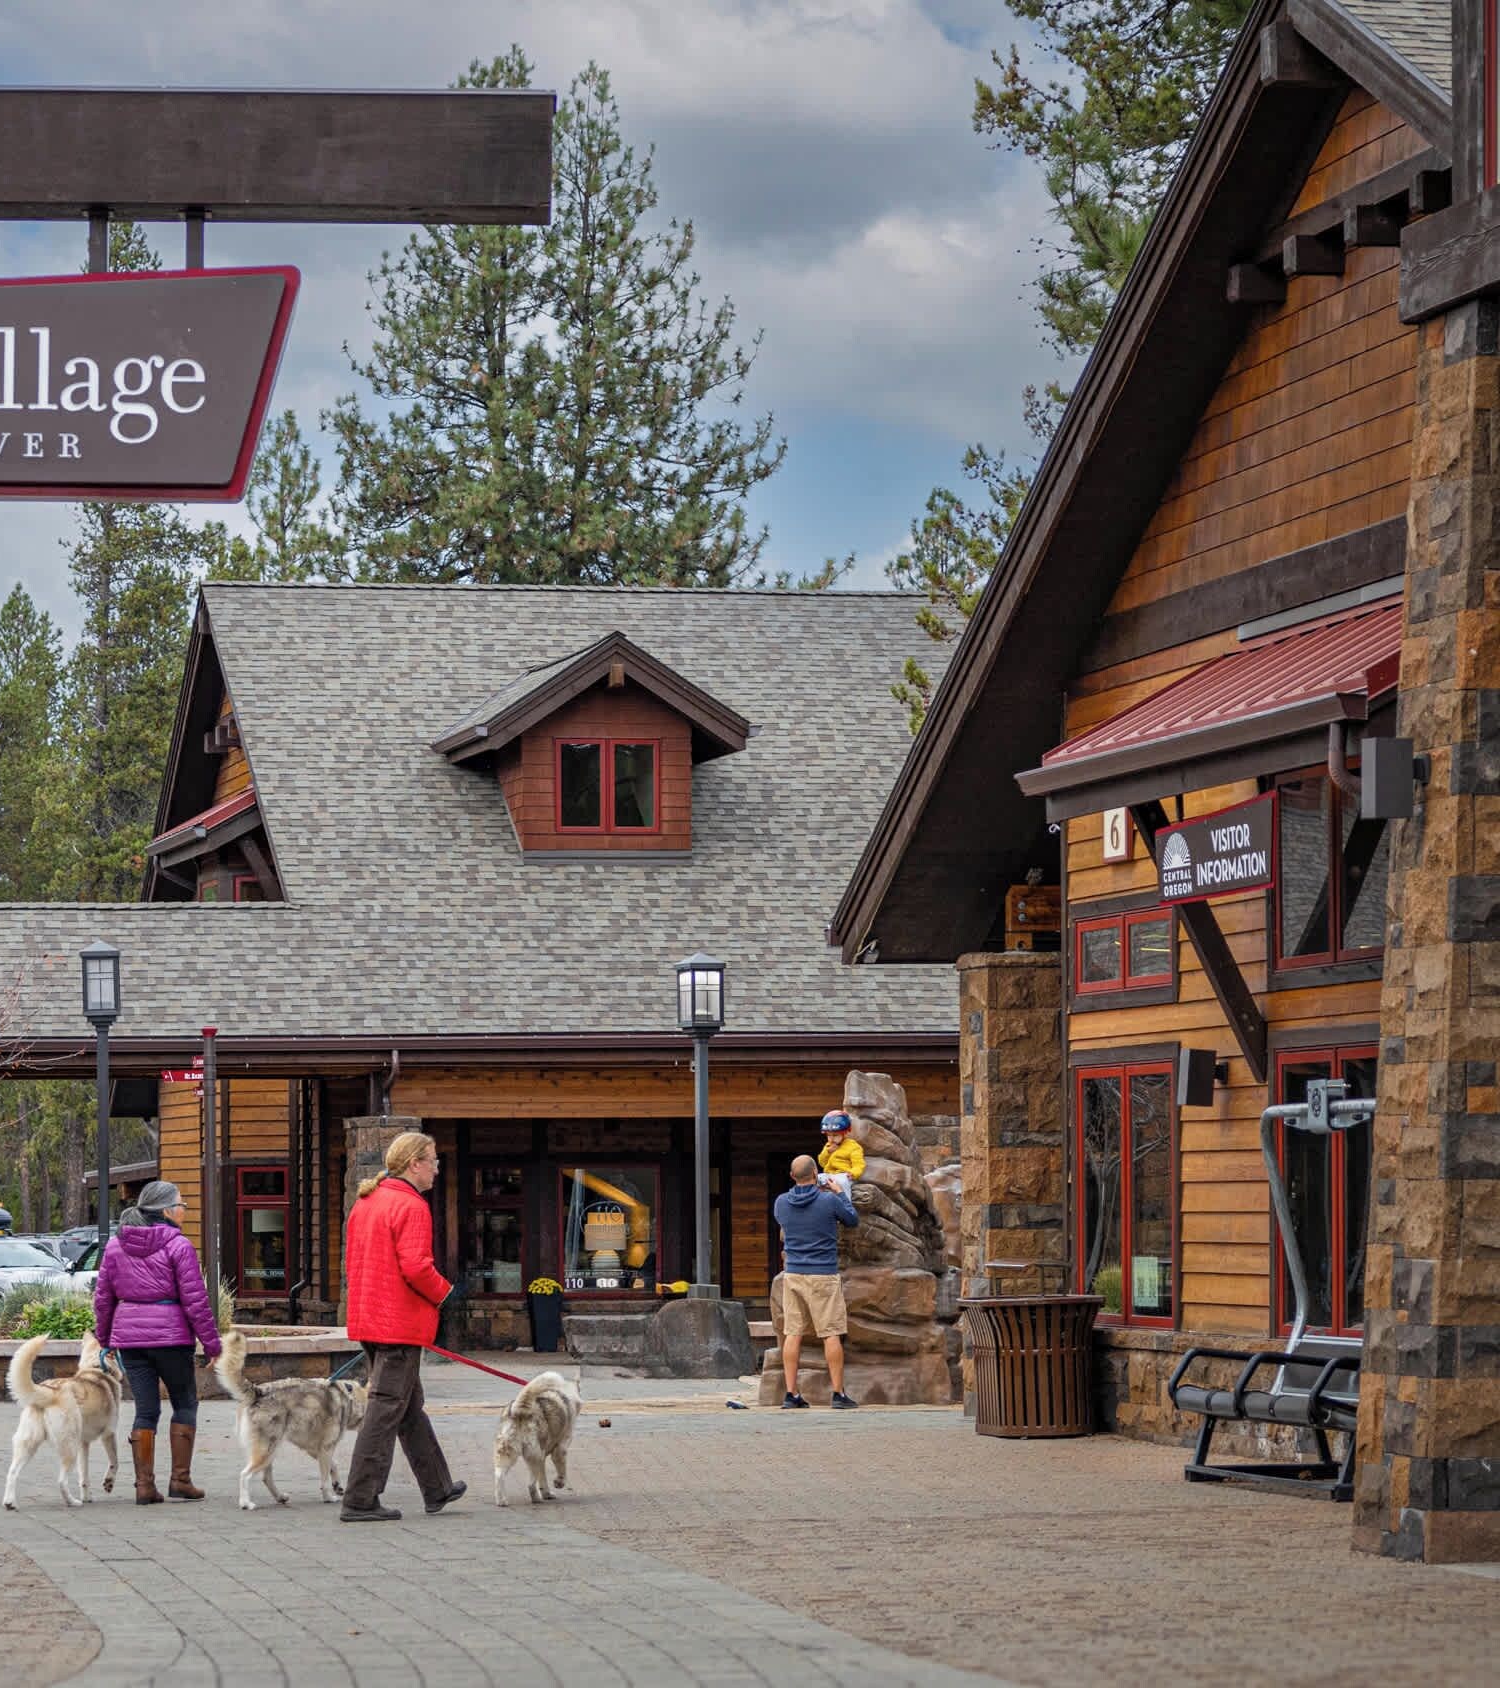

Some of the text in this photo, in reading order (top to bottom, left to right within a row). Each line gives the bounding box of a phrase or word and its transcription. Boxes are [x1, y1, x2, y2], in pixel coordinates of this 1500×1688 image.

[1110, 814, 1120, 851] 6
[1211, 823, 1251, 853] VISITOR
[1163, 869, 1192, 883] CENTRAL
[1196, 850, 1267, 886] INFORMATION
[1163, 881, 1193, 897] OREGON
[564, 1278, 584, 1289] 110
